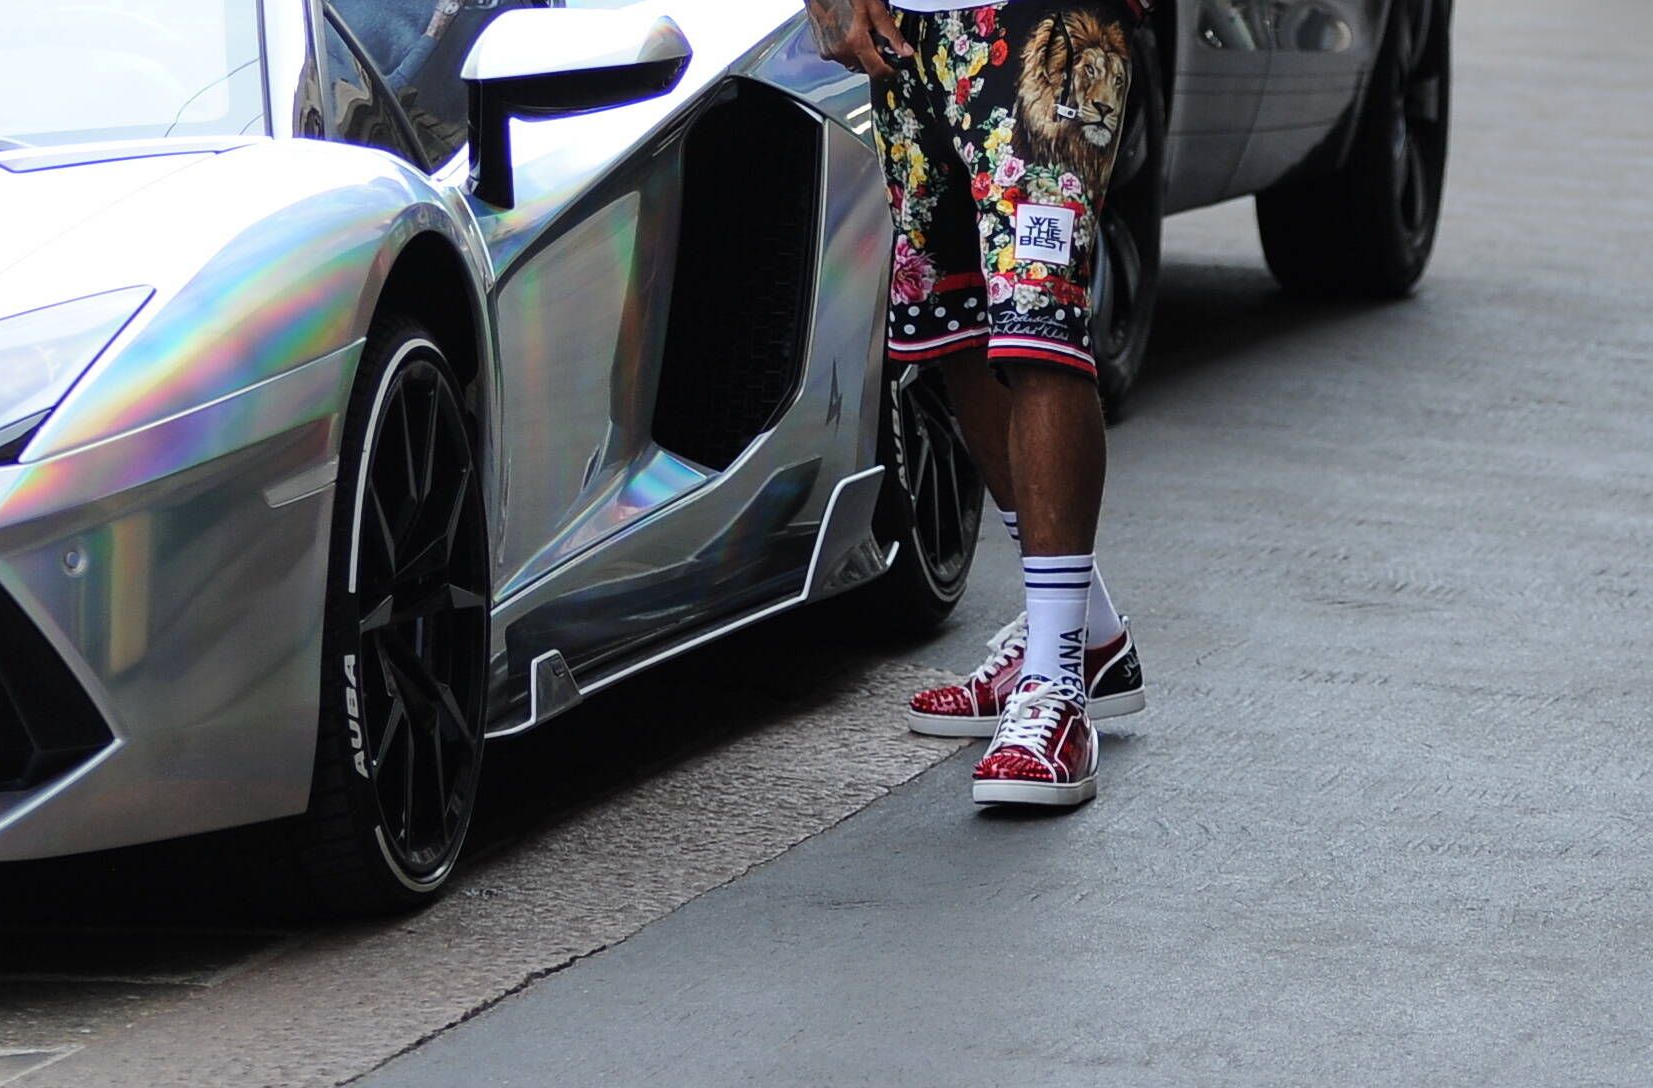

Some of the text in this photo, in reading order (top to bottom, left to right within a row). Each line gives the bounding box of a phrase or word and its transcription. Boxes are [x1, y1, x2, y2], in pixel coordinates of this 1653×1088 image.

[1029, 216, 1060, 229] WE
[1025, 225, 1062, 240] THE
[1019, 235, 1067, 252] BEST
[343, 654, 370, 779] AUBA
